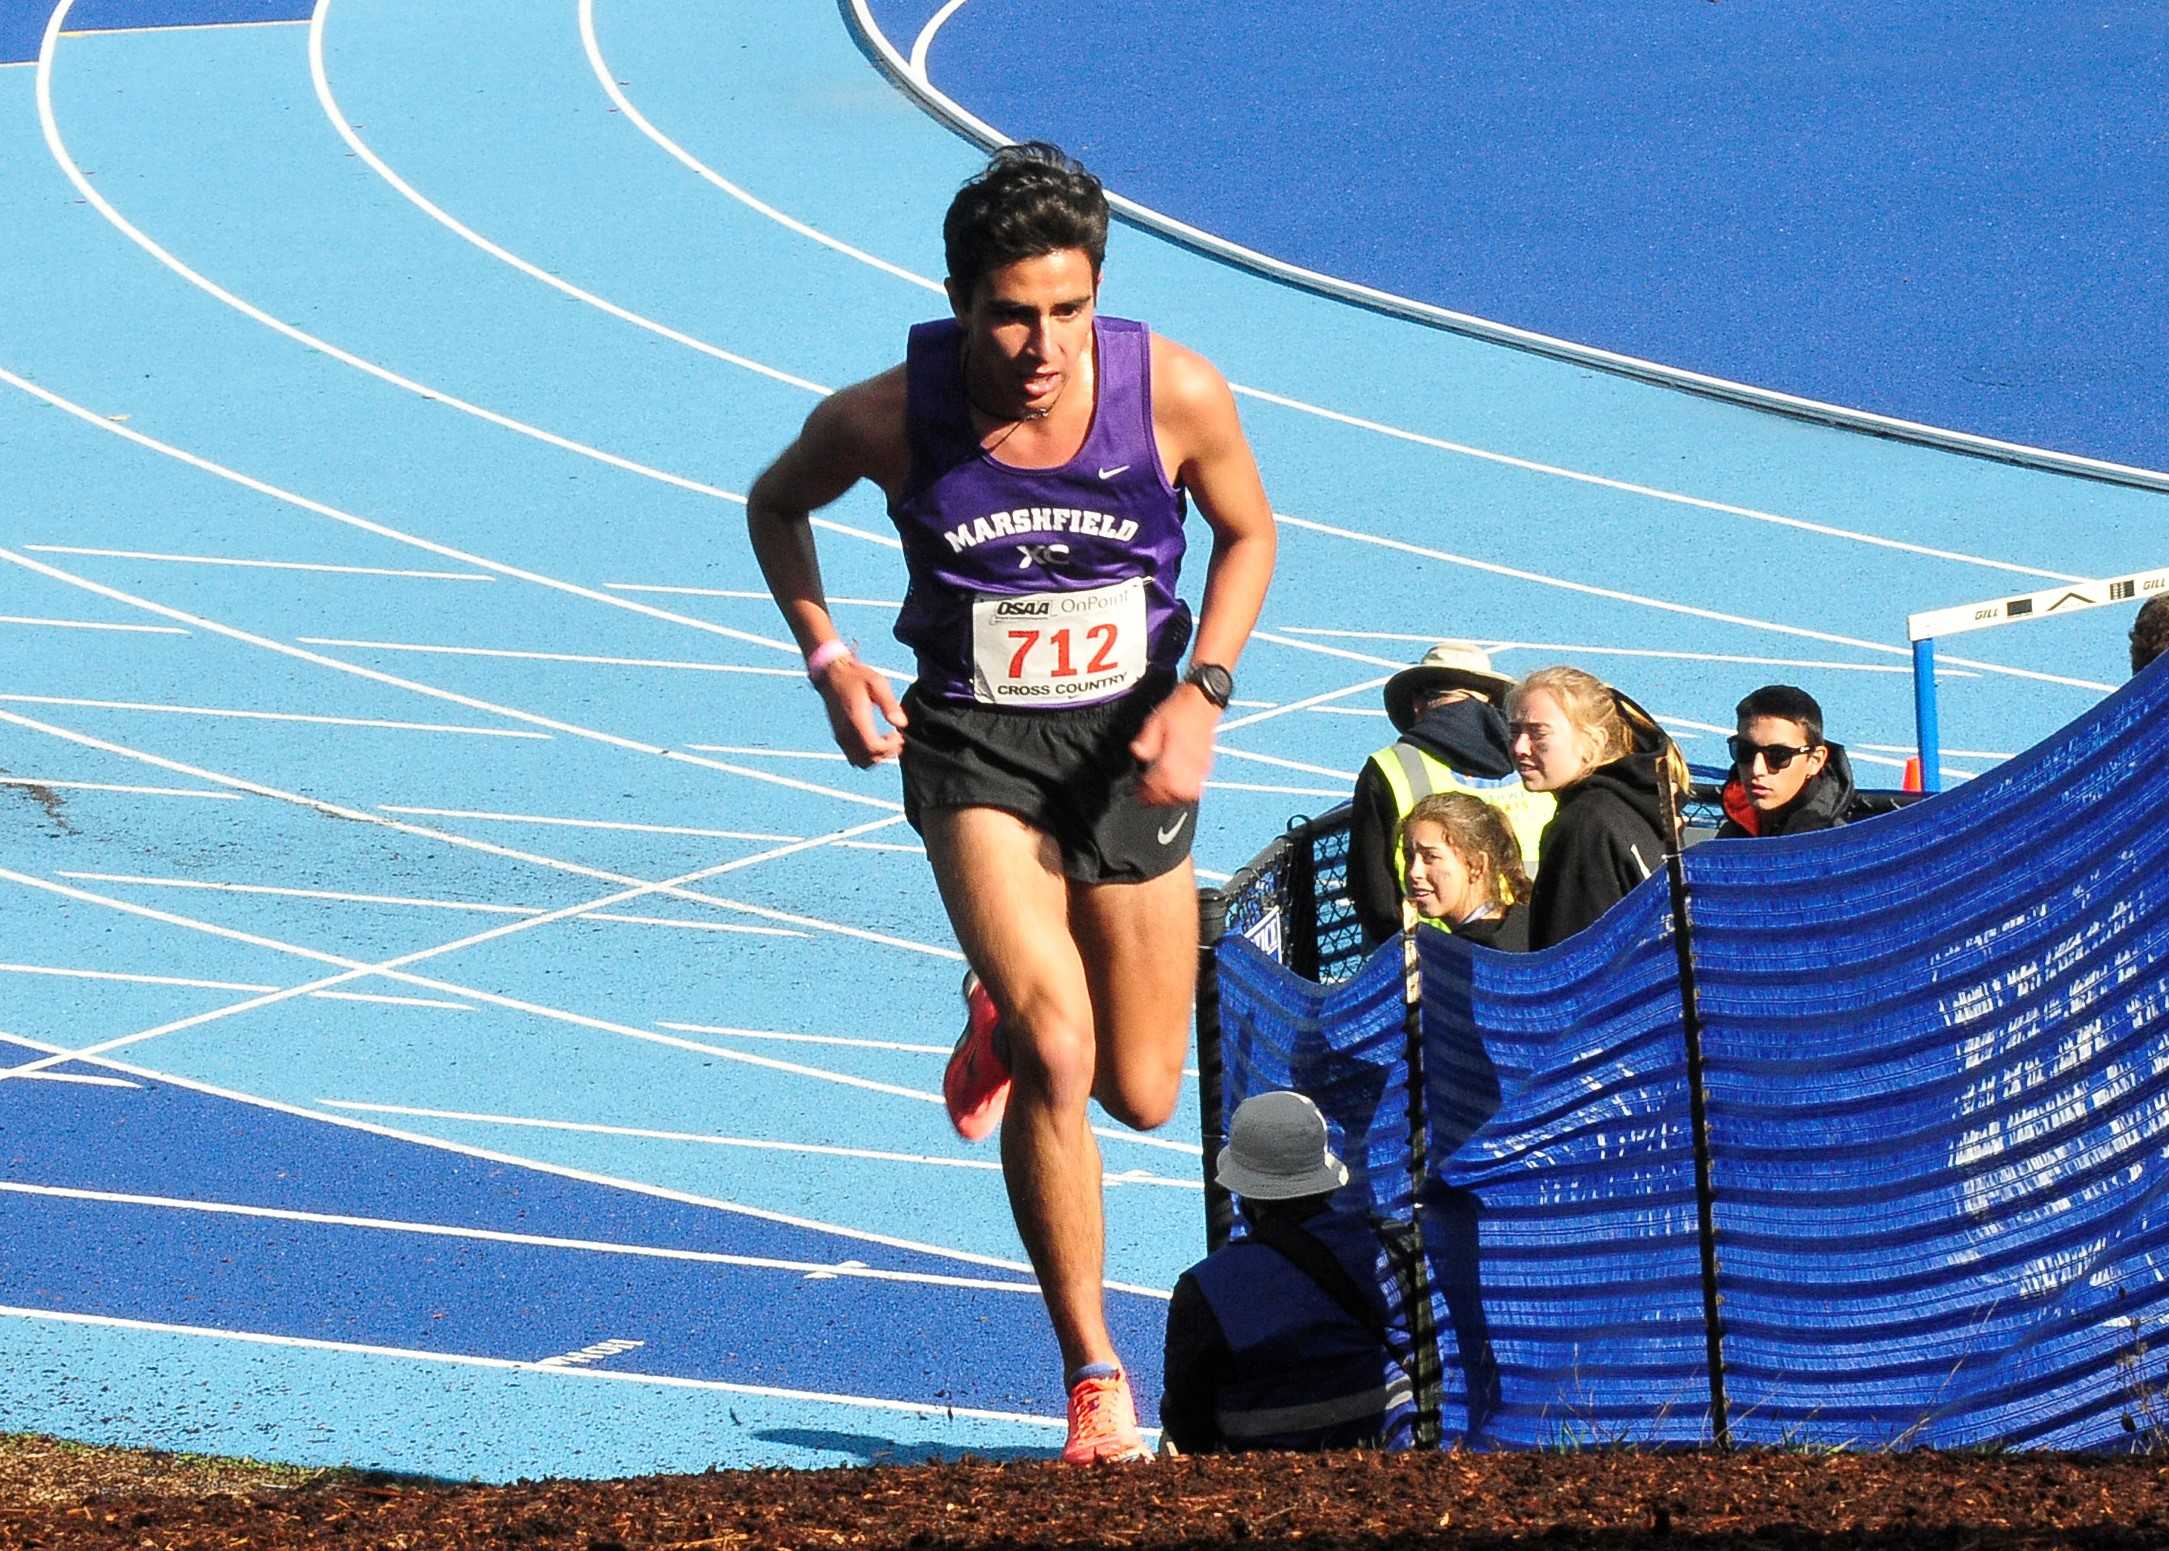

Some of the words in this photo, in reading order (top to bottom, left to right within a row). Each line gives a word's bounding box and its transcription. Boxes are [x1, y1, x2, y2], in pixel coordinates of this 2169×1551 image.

[944, 508, 1139, 553] MARSHFIELD
[1017, 545, 1070, 568] XC
[2143, 579, 2166, 591] GILL
[997, 602, 1049, 615] OSAA
[1975, 607, 1999, 621] GILL
[1008, 623, 1118, 679] 712
[997, 684, 1050, 696] CROSS
[1055, 673, 1126, 695] COUNTRY
